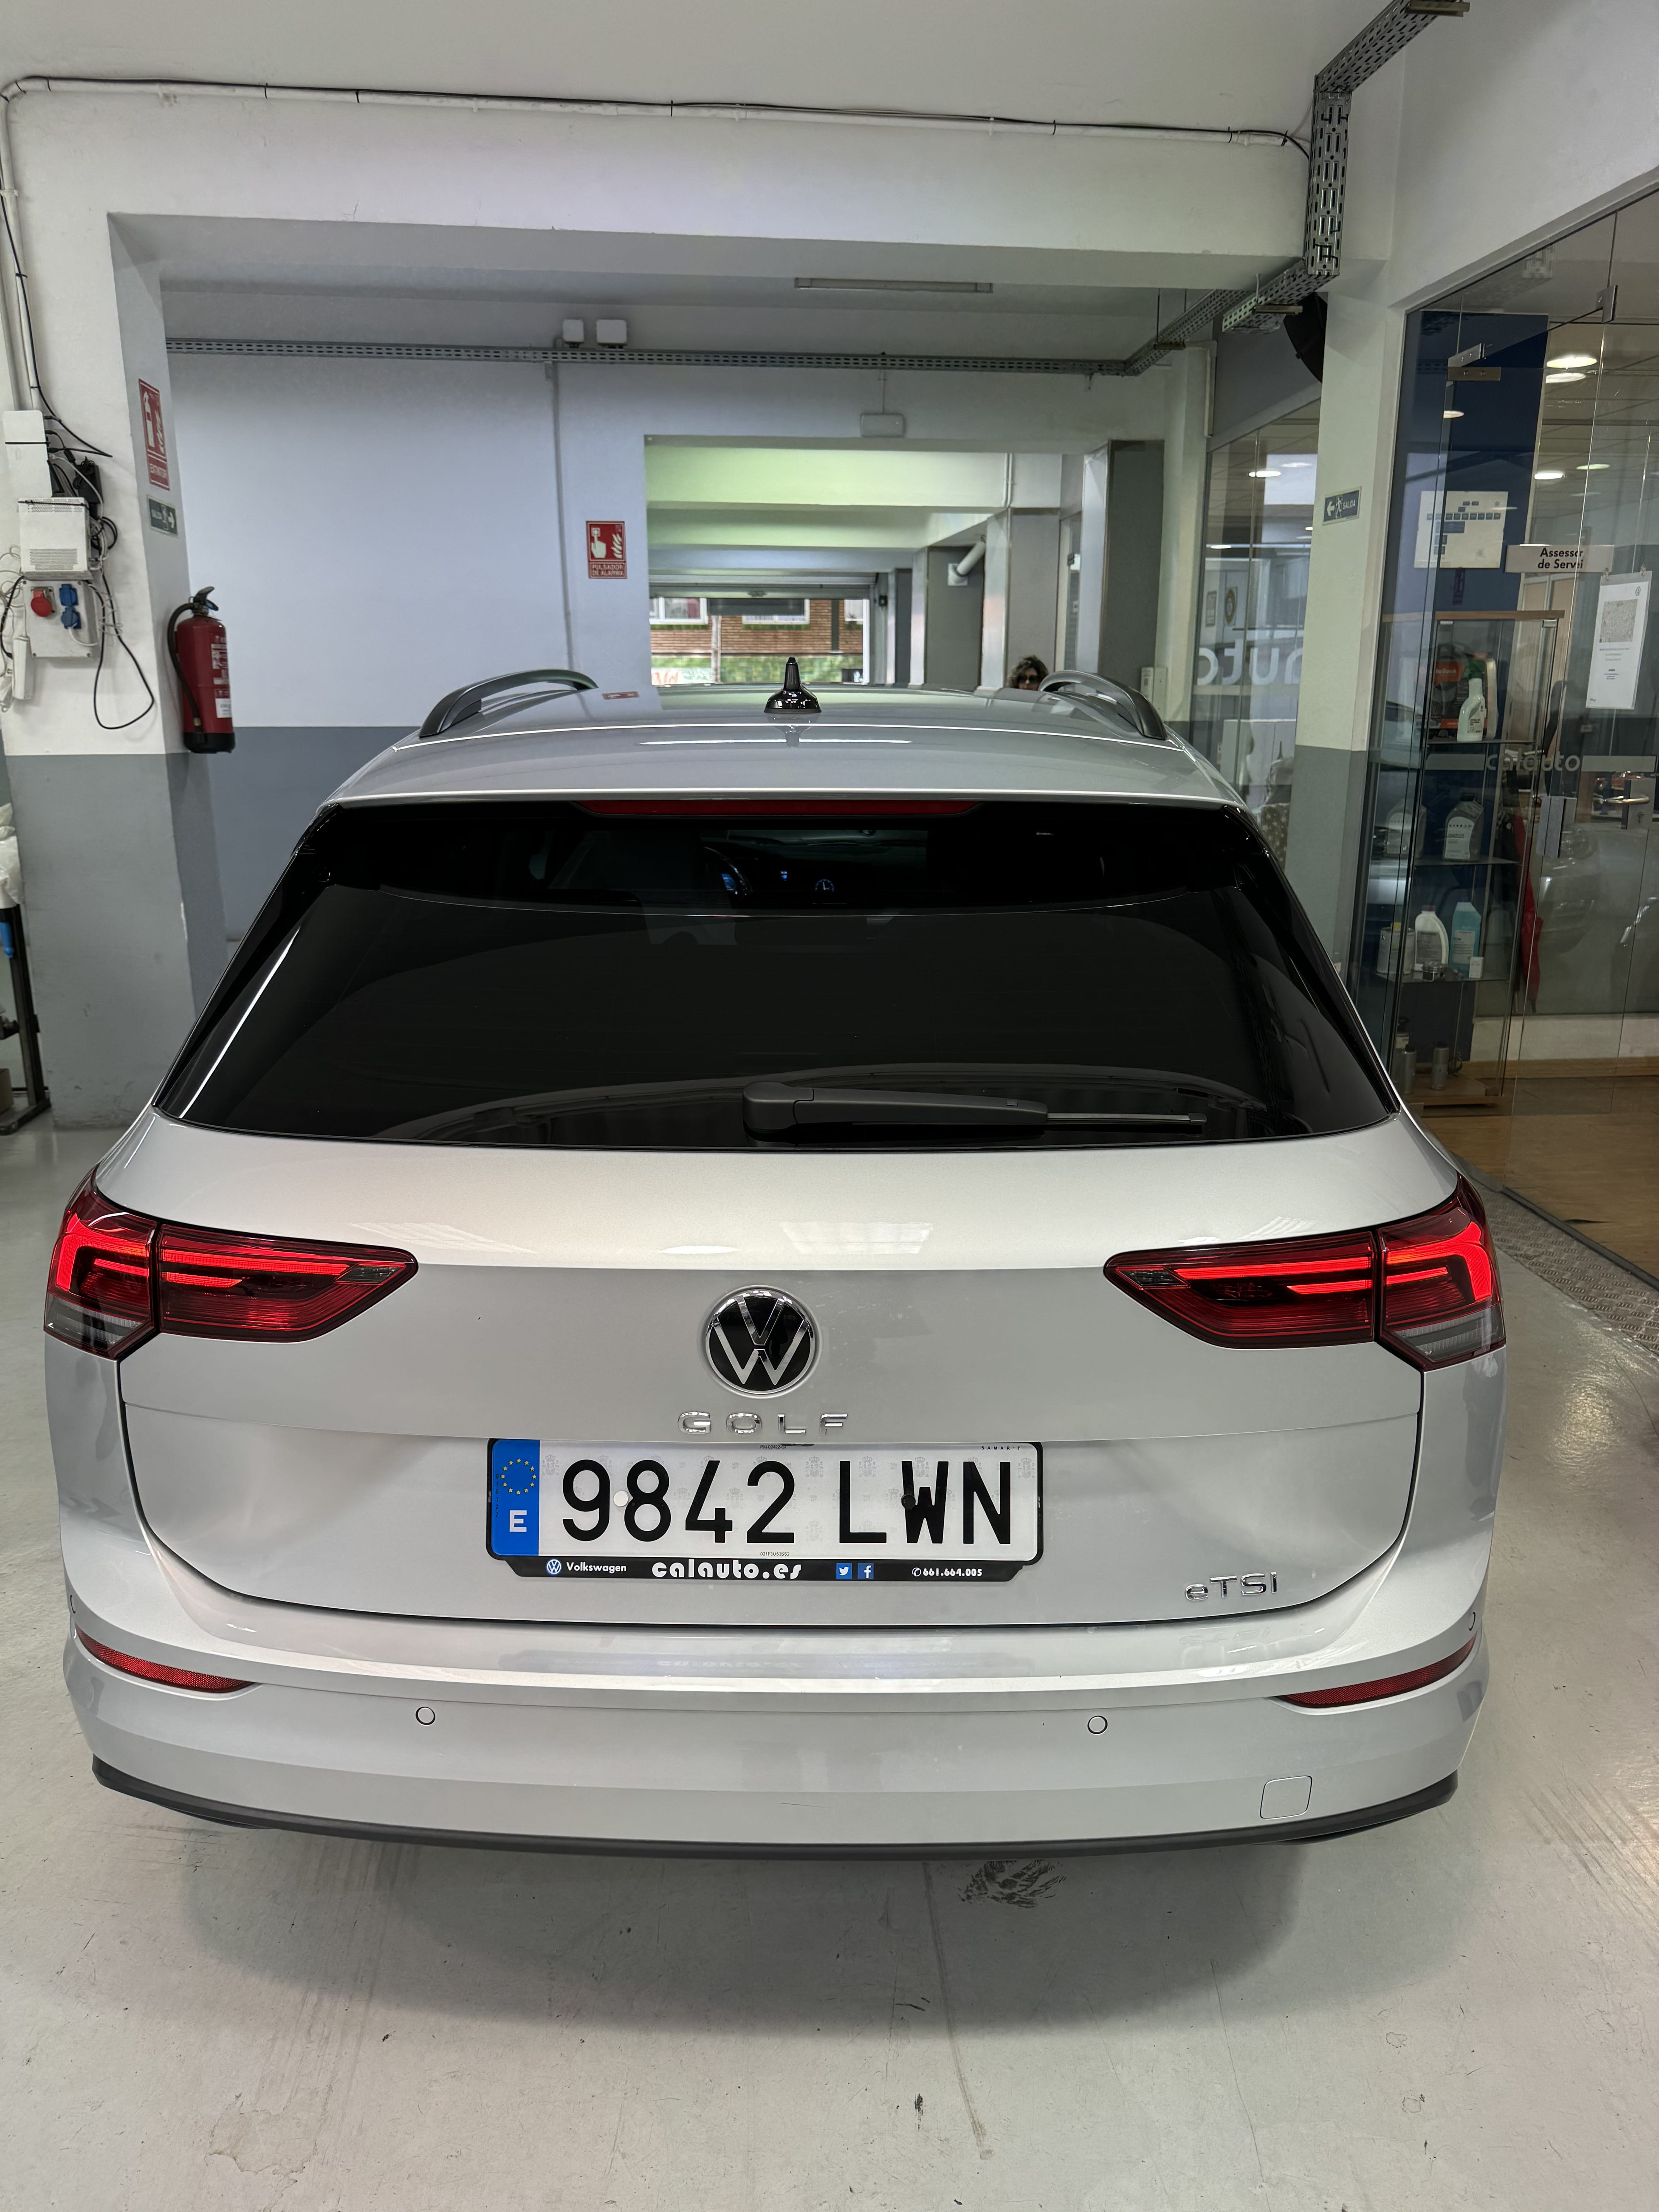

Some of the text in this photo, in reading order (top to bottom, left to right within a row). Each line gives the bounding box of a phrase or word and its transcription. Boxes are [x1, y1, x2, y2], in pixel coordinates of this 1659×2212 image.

[150, 464, 167, 478] EXTINTOR
[1343, 499, 1355, 510] SALIDA
[1540, 547, 1583, 557] Assessor
[1537, 559, 1583, 569] de Servei
[678, 1411, 848, 1435] GOLF
[562, 1459, 1011, 1544] 9842 LWN
[509, 1510, 527, 1532] E
[566, 1561, 627, 1574] Volkswagen
[652, 1559, 802, 1580] calauto.es
[923, 1568, 982, 1577] 661.664.005
[1185, 1571, 1278, 1601] eTSI
